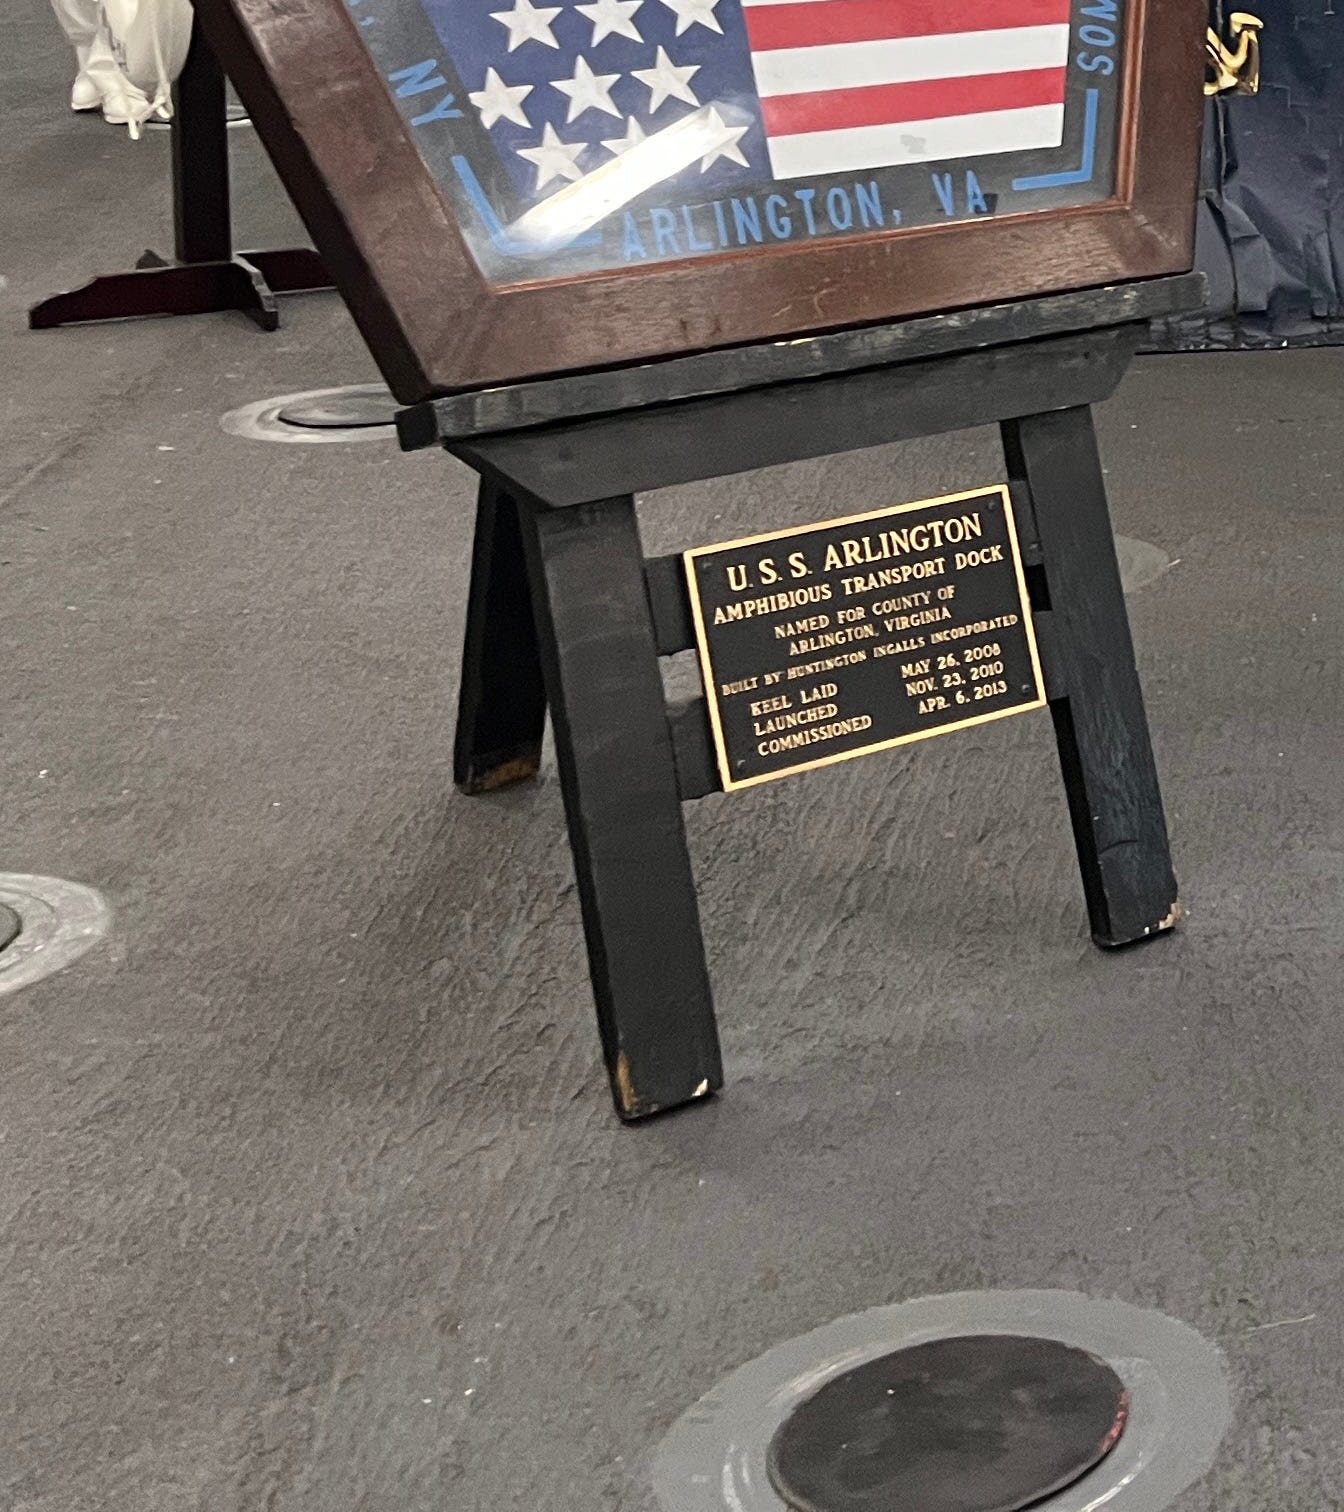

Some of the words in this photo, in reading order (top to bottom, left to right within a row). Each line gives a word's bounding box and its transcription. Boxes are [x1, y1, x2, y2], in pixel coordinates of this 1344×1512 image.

[389, 58, 464, 127] NY
[622, 180, 901, 262] ARLINGTON,
[932, 170, 988, 217] VA
[713, 584, 833, 626] AMPHIBIOUS
[841, 557, 946, 596] TRANSPORT
[954, 544, 1005, 571] DOCK
[726, 564, 754, 592] U.
[758, 558, 784, 585] S.
[788, 552, 813, 578] S.
[823, 513, 983, 572] ARLINGTON
[774, 614, 831, 640] NAMED
[836, 606, 867, 624] FOR
[872, 590, 932, 617] COUNTY
[937, 585, 956, 602] OF
[883, 605, 952, 633] VIRGINIA
[721, 676, 759, 697] BUILT
[763, 671, 784, 686] BY
[786, 649, 868, 681] HUNTINGTON
[873, 636, 926, 659] INGALLS
[930, 614, 1019, 645] INCORPORATED
[750, 695, 793, 717] KEEL
[800, 682, 839, 704] LAID
[901, 658, 931, 679] MAY
[963, 642, 1002, 663] 2008
[753, 702, 839, 737] LAUNCHED
[905, 677, 939, 697] NOV.
[969, 660, 1004, 681] 2010
[757, 714, 873, 757] COMMISSIONED
[918, 695, 951, 715] APR.
[973, 679, 1008, 700] 2013
